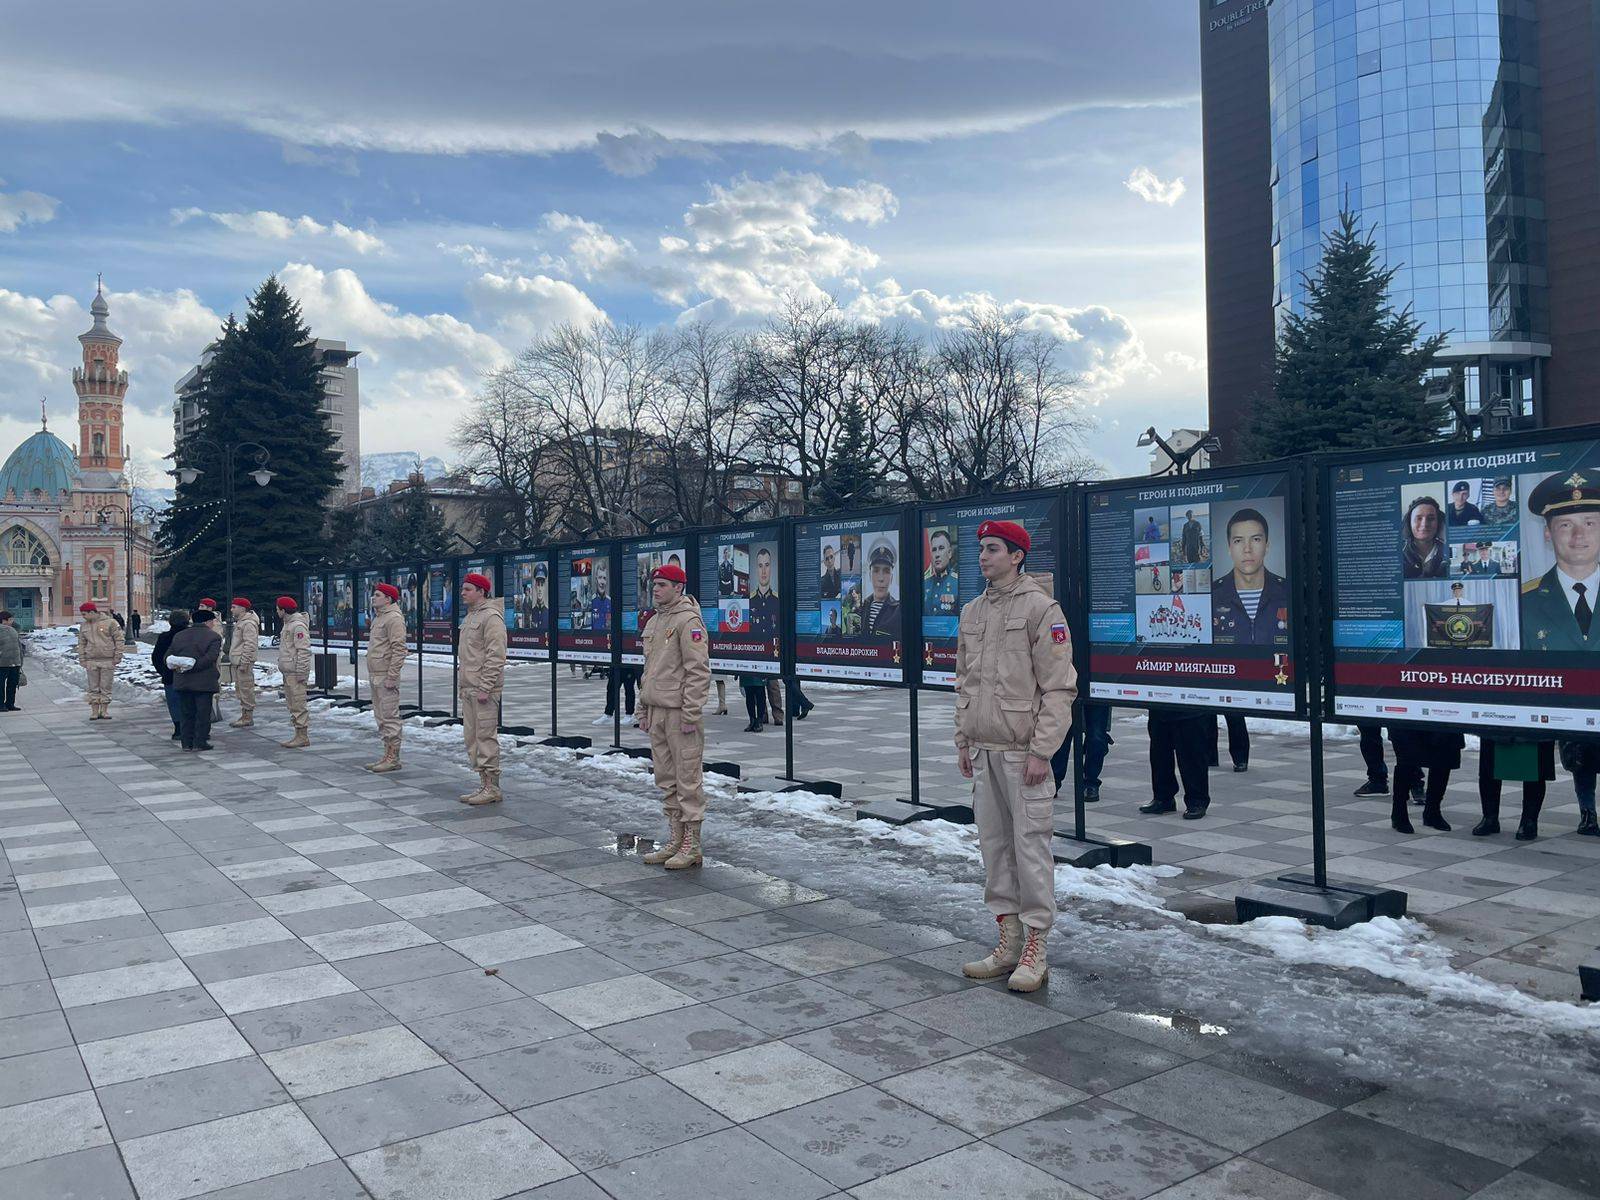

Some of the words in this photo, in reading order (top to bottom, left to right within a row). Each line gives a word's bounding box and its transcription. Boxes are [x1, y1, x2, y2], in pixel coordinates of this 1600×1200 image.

[1408, 459, 1451, 474] ГЕРОИ
[1453, 458, 1464, 470] И
[1466, 451, 1537, 469] ПОДВИГИ
[1139, 489, 1167, 501] ГЕРОИ
[1169, 488, 1176, 498] И
[1177, 483, 1223, 497] ПОДВИГИ
[956, 508, 977, 518] ГЕРОИ
[977, 508, 983, 516] И
[983, 504, 1015, 516] ПОДВИГИ
[816, 646, 850, 656] ВЛАДИСЛАВ
[850, 648, 879, 657] ДОРОХИН
[1135, 659, 1173, 672] АЙМИР
[1174, 662, 1236, 675] МИЯГАШЕВ
[1400, 670, 1448, 684] ИГОРЬ
[1451, 672, 1563, 688] НАСИБУЛЛИН
